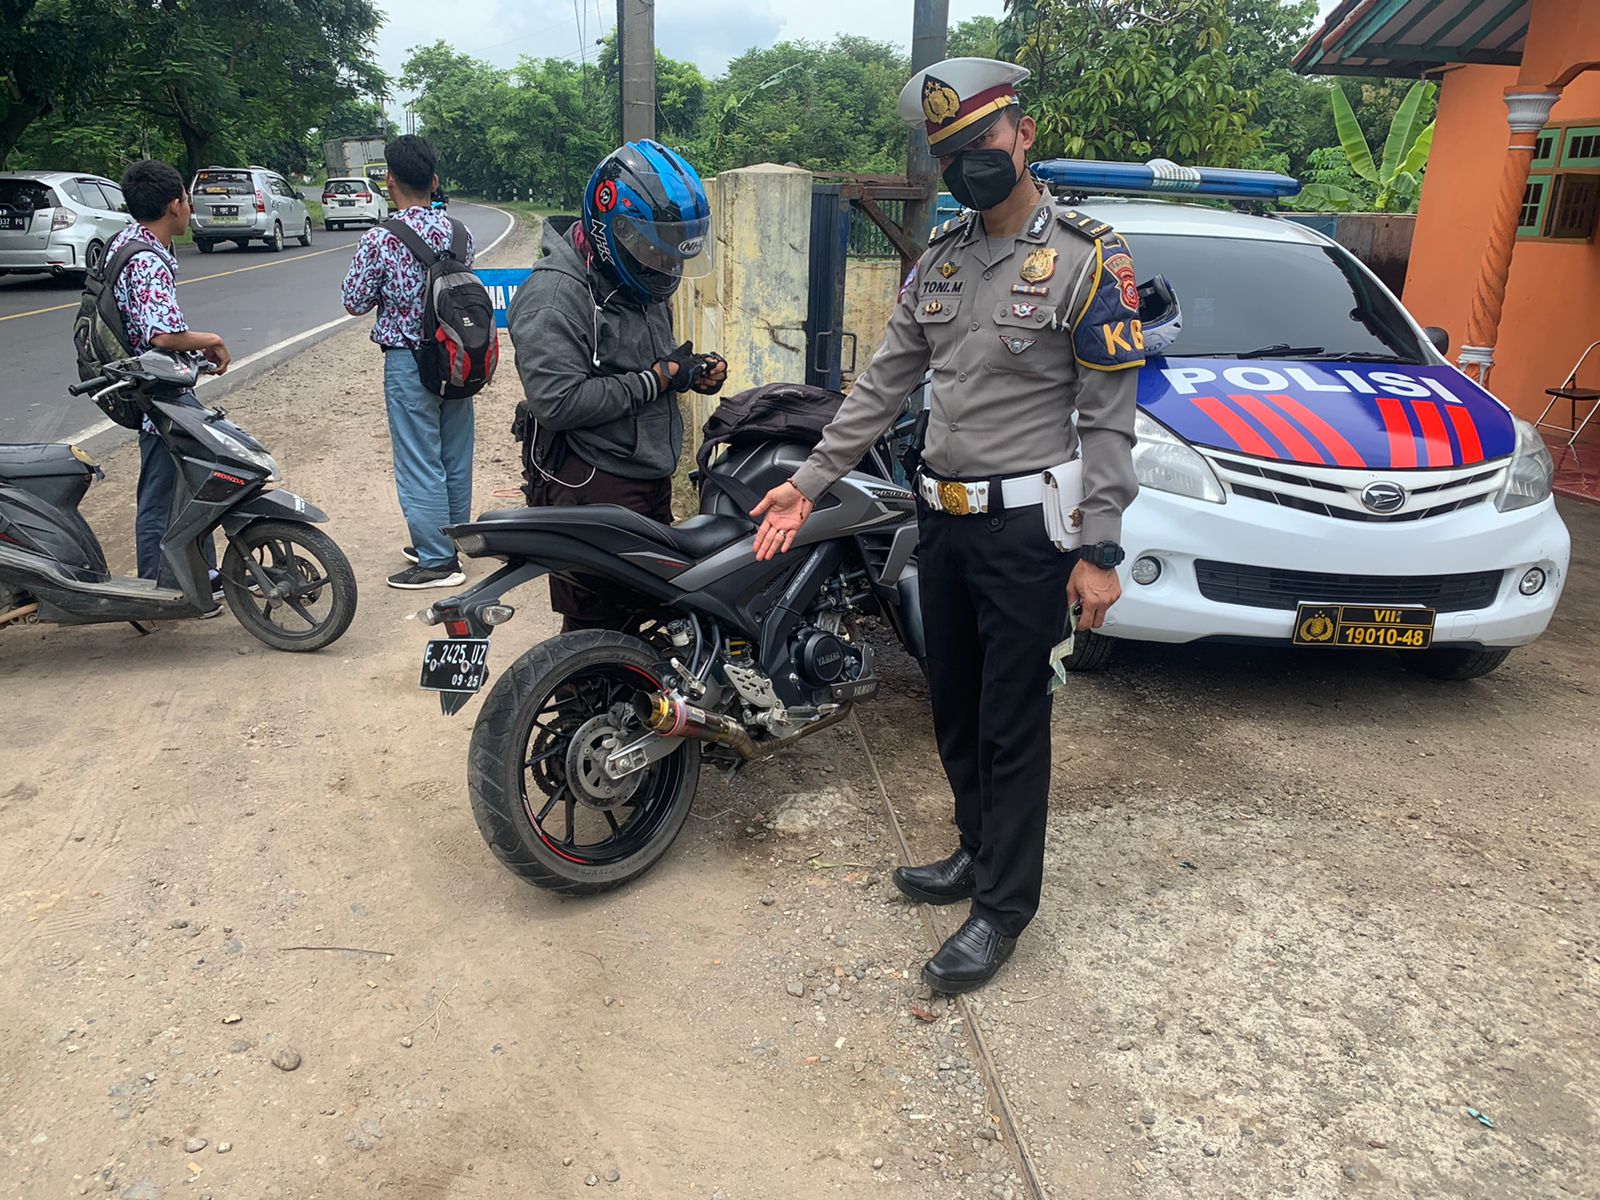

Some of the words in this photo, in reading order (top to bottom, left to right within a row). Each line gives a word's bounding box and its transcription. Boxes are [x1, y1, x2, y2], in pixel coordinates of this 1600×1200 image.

[1160, 367, 1464, 405] POLISI
[213, 471, 245, 486] HONDA
[1345, 627, 1424, 646] 19010-48
[425, 643, 434, 663] E
[440, 643, 468, 664] 2425
[471, 643, 488, 665] UZ
[816, 651, 841, 667] YAMAHA
